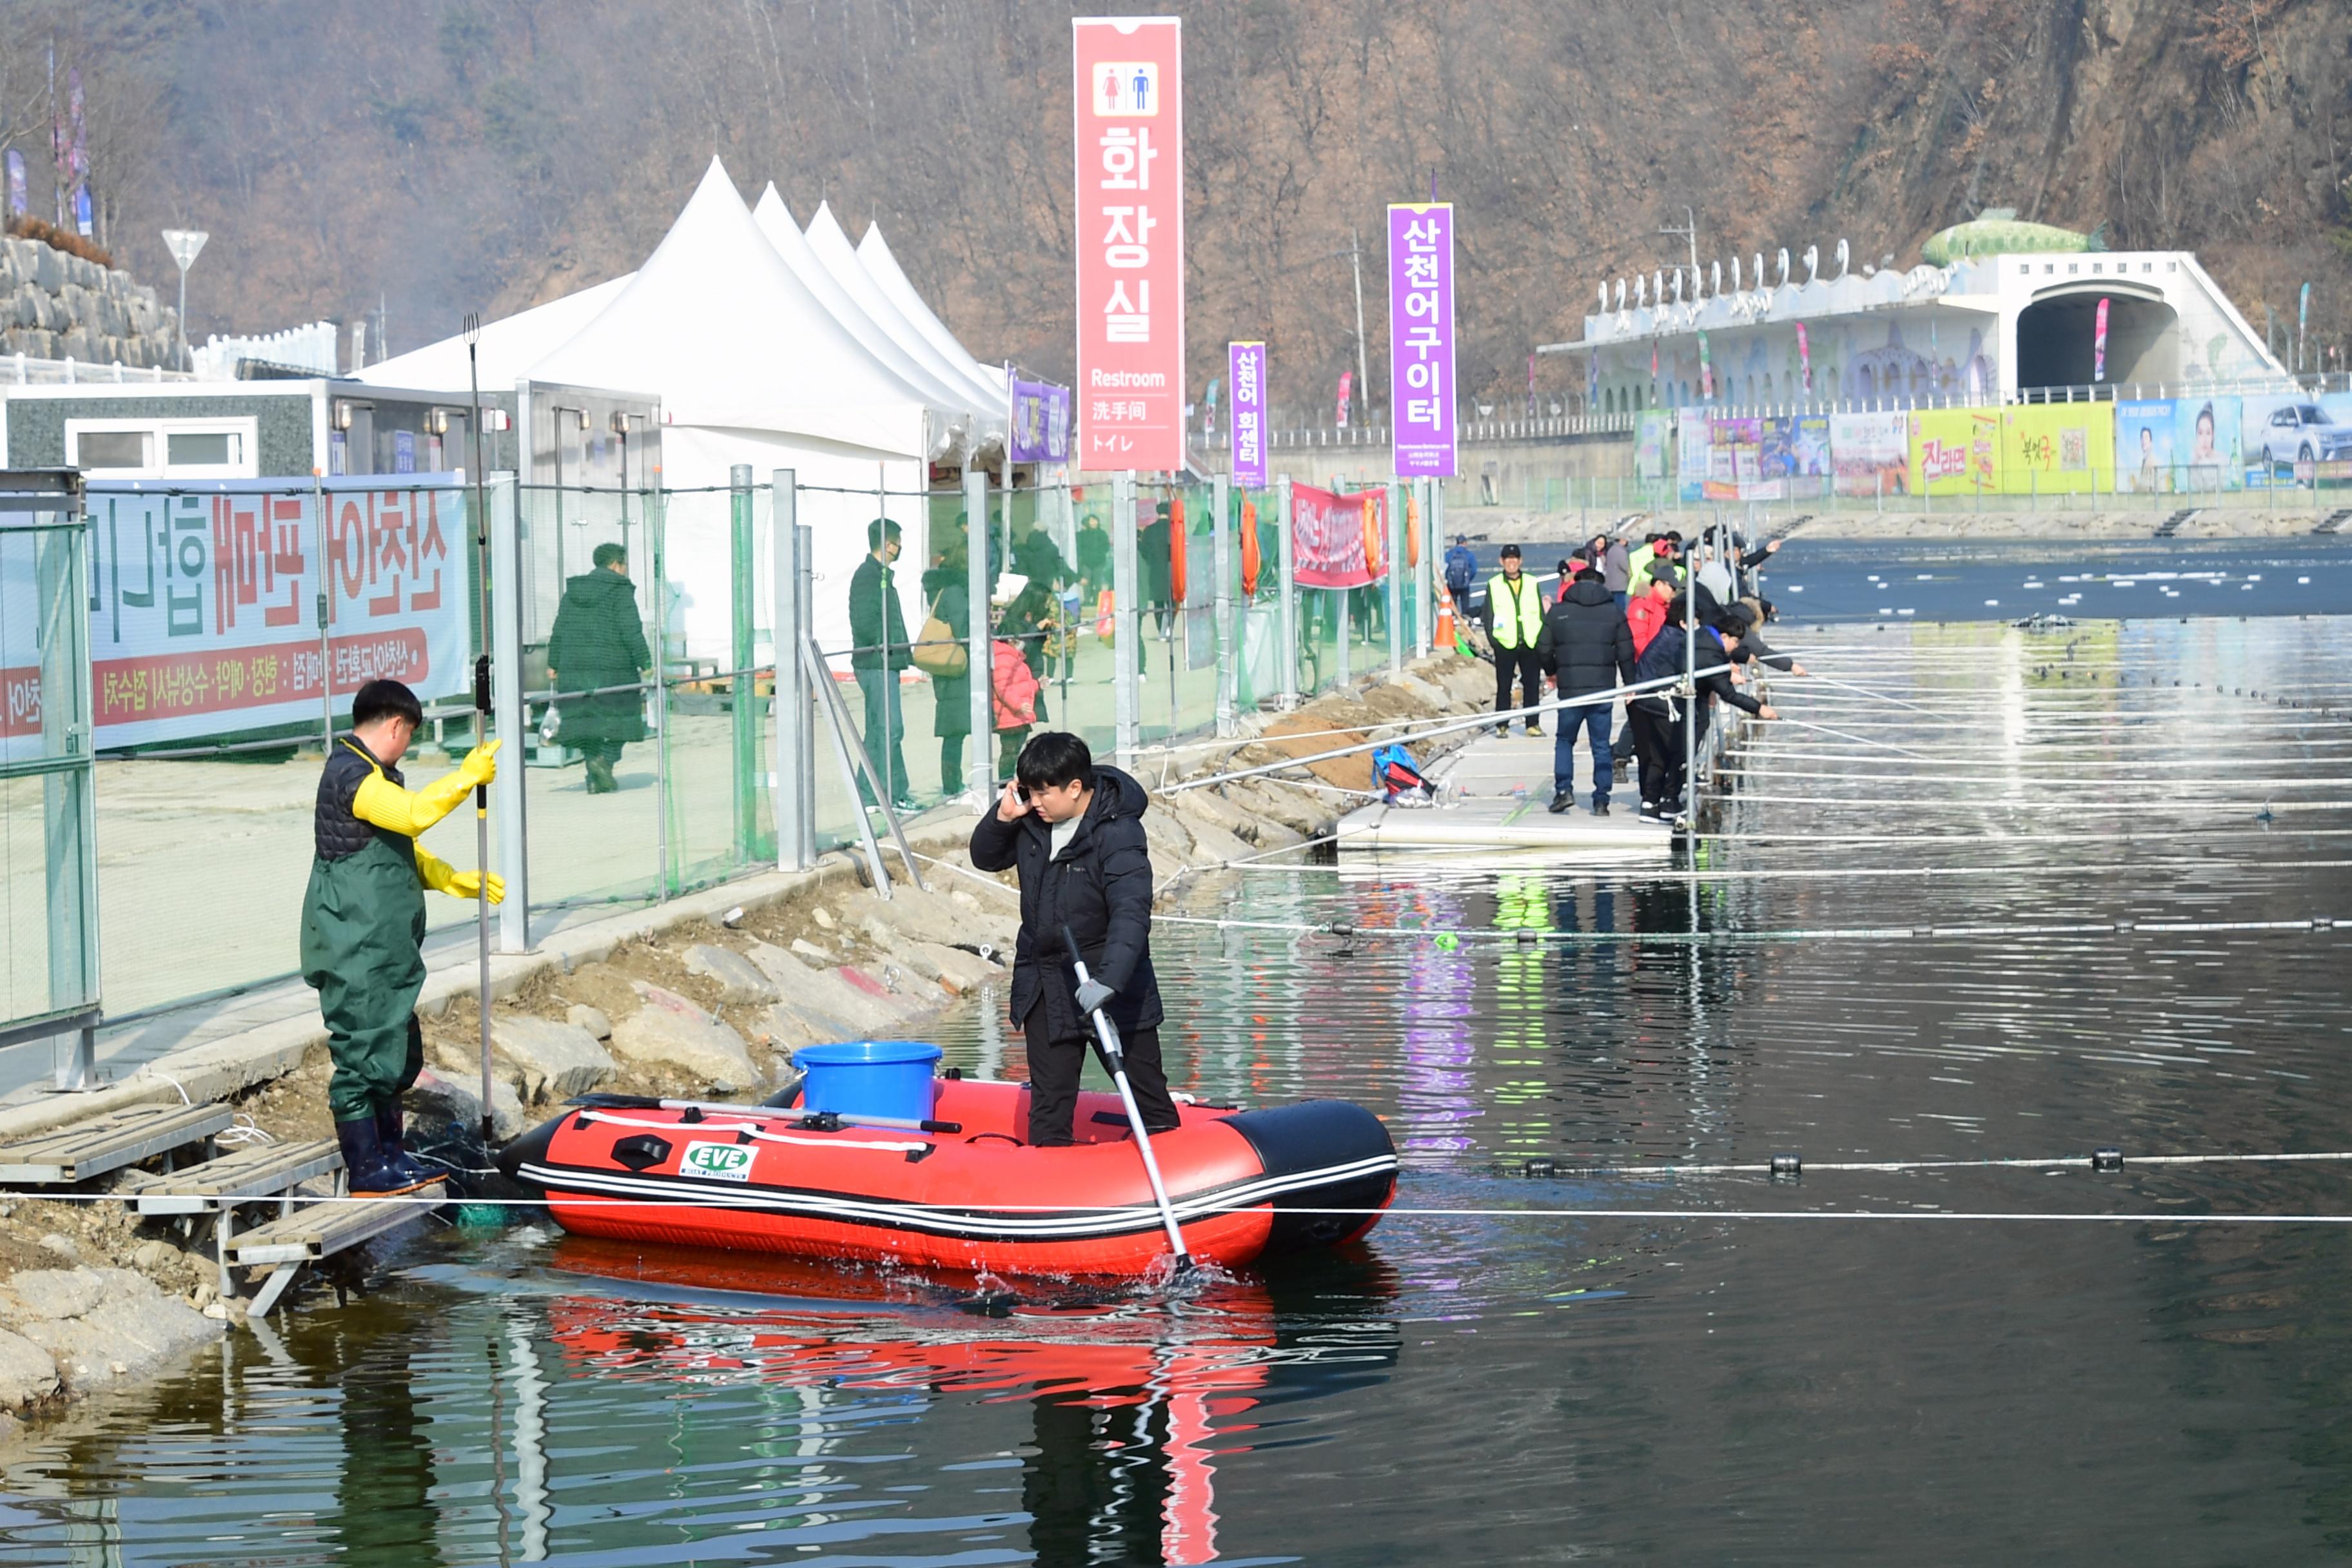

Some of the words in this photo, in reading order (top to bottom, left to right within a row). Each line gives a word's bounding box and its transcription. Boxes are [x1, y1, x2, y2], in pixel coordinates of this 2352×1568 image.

[1099, 126, 1158, 342] 화장실
[1402, 218, 1442, 431] 산천어구이터
[1091, 368, 1165, 387] Restroom
[1237, 351, 1258, 407] 산천어
[1092, 400, 1146, 420] 洗手间
[1093, 434, 1133, 452] トイレ
[1237, 411, 1259, 467] 회센터
[1922, 438, 1966, 480] 진라면
[695, 1148, 743, 1168] EVE
